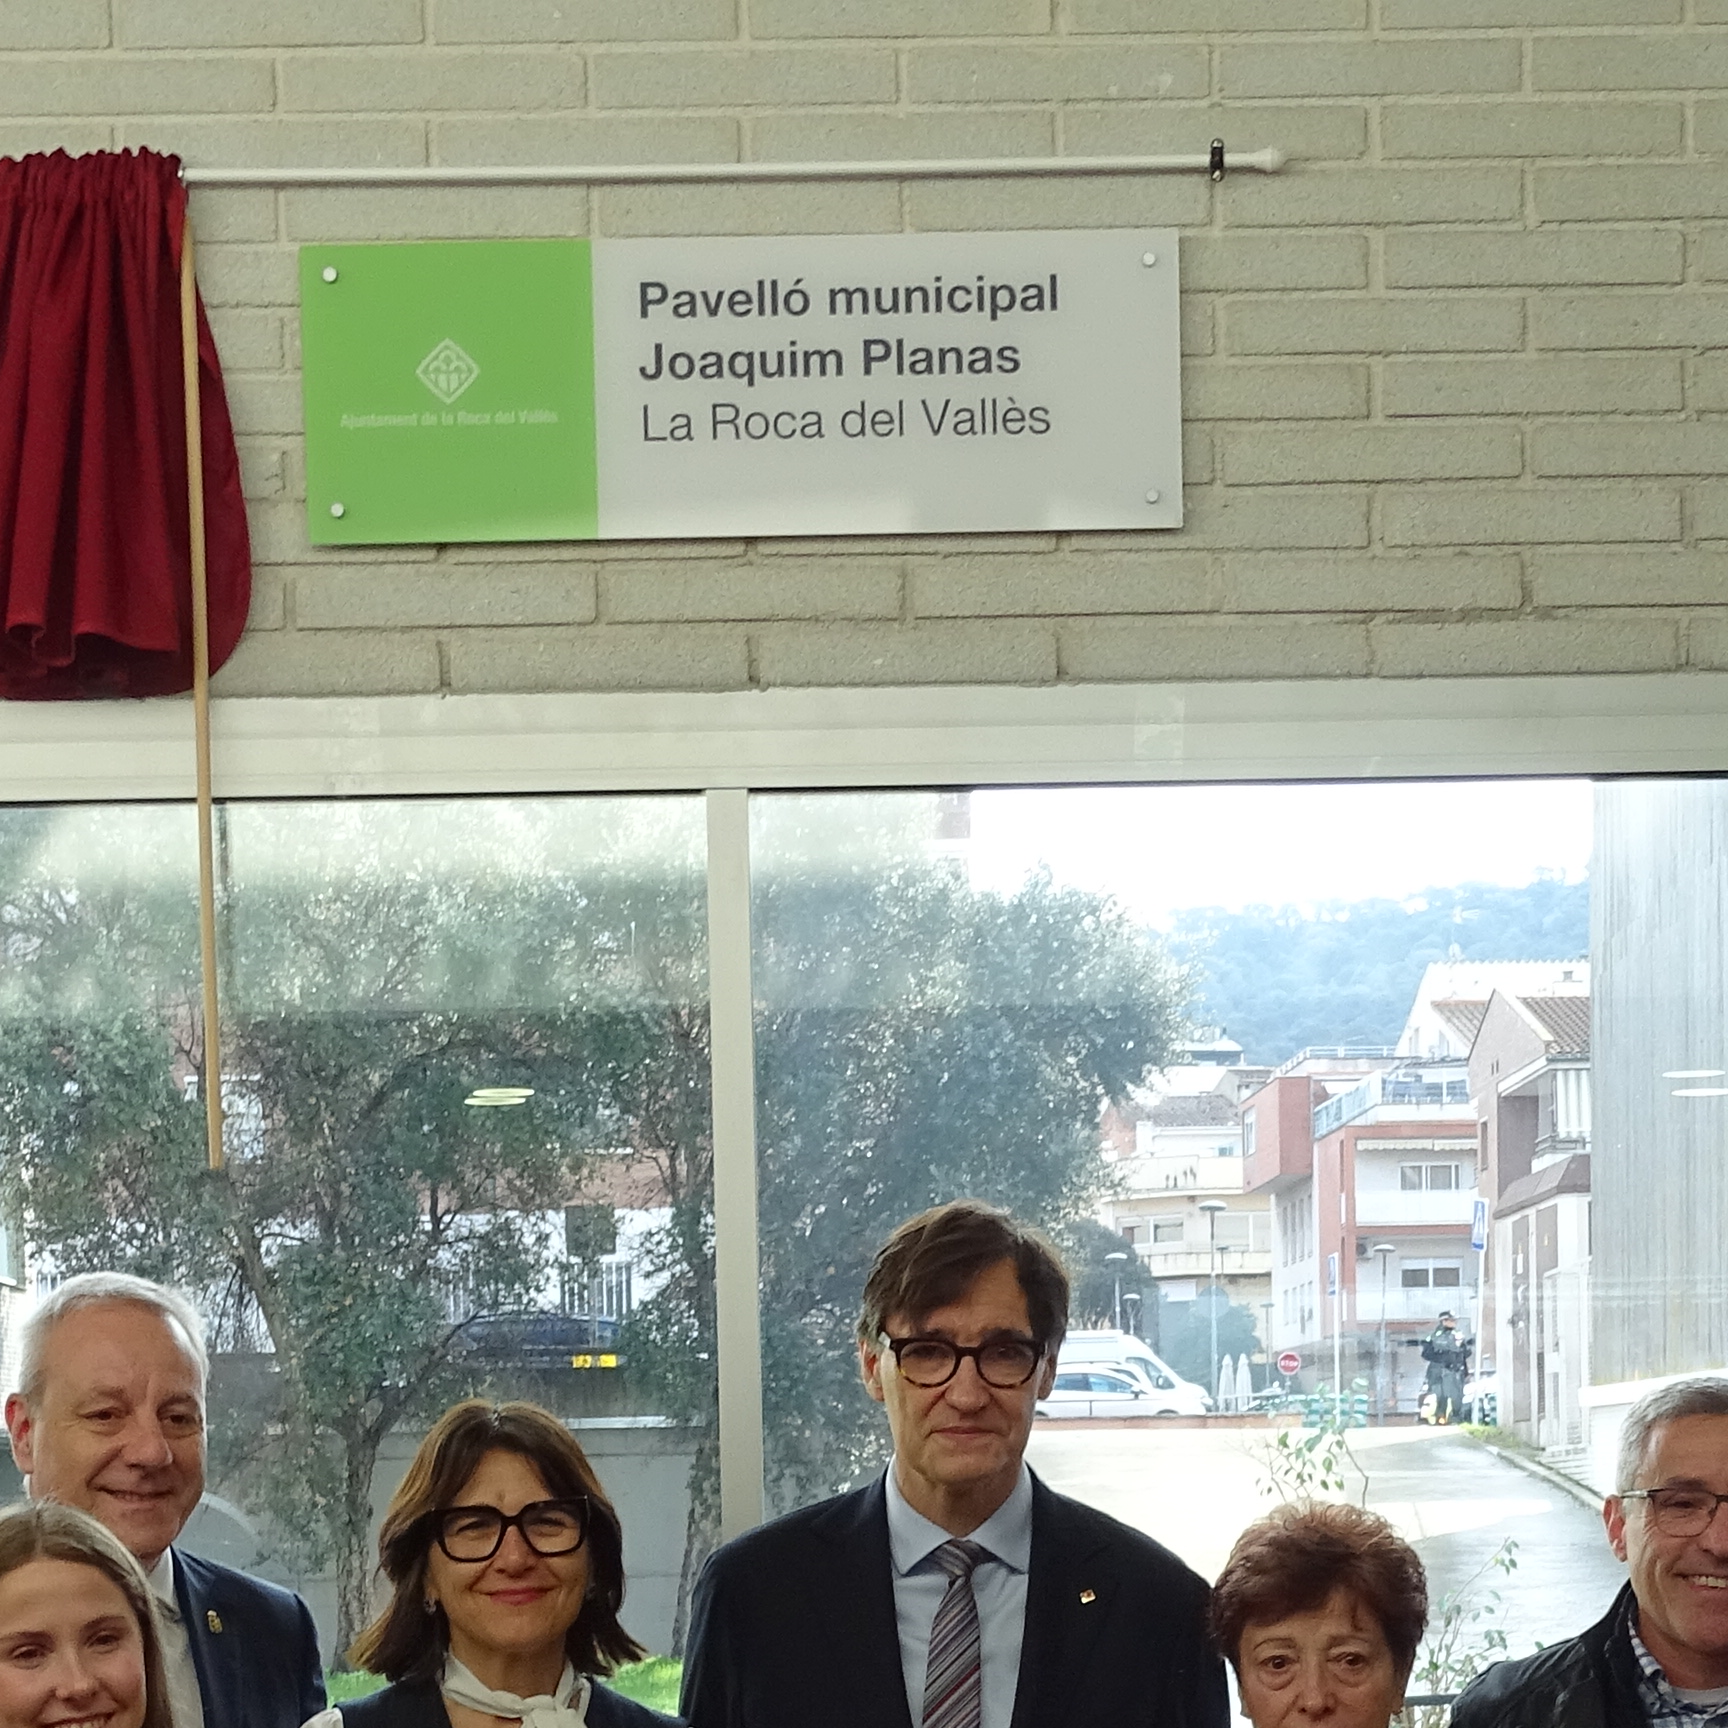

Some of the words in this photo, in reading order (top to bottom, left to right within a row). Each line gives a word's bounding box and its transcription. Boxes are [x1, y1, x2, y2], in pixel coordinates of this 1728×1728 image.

[639, 277, 811, 319] Pavelló
[828, 273, 1058, 321] municipal
[638, 340, 844, 387] Joaquim
[862, 338, 1021, 376] Planas
[340, 413, 418, 430] Ajuntament
[421, 411, 438, 426] de
[457, 410, 491, 426] Roca
[494, 409, 516, 425] del
[643, 403, 694, 441] La
[711, 403, 825, 440] Roca
[840, 399, 905, 438] del
[920, 396, 1051, 436] Vallès
